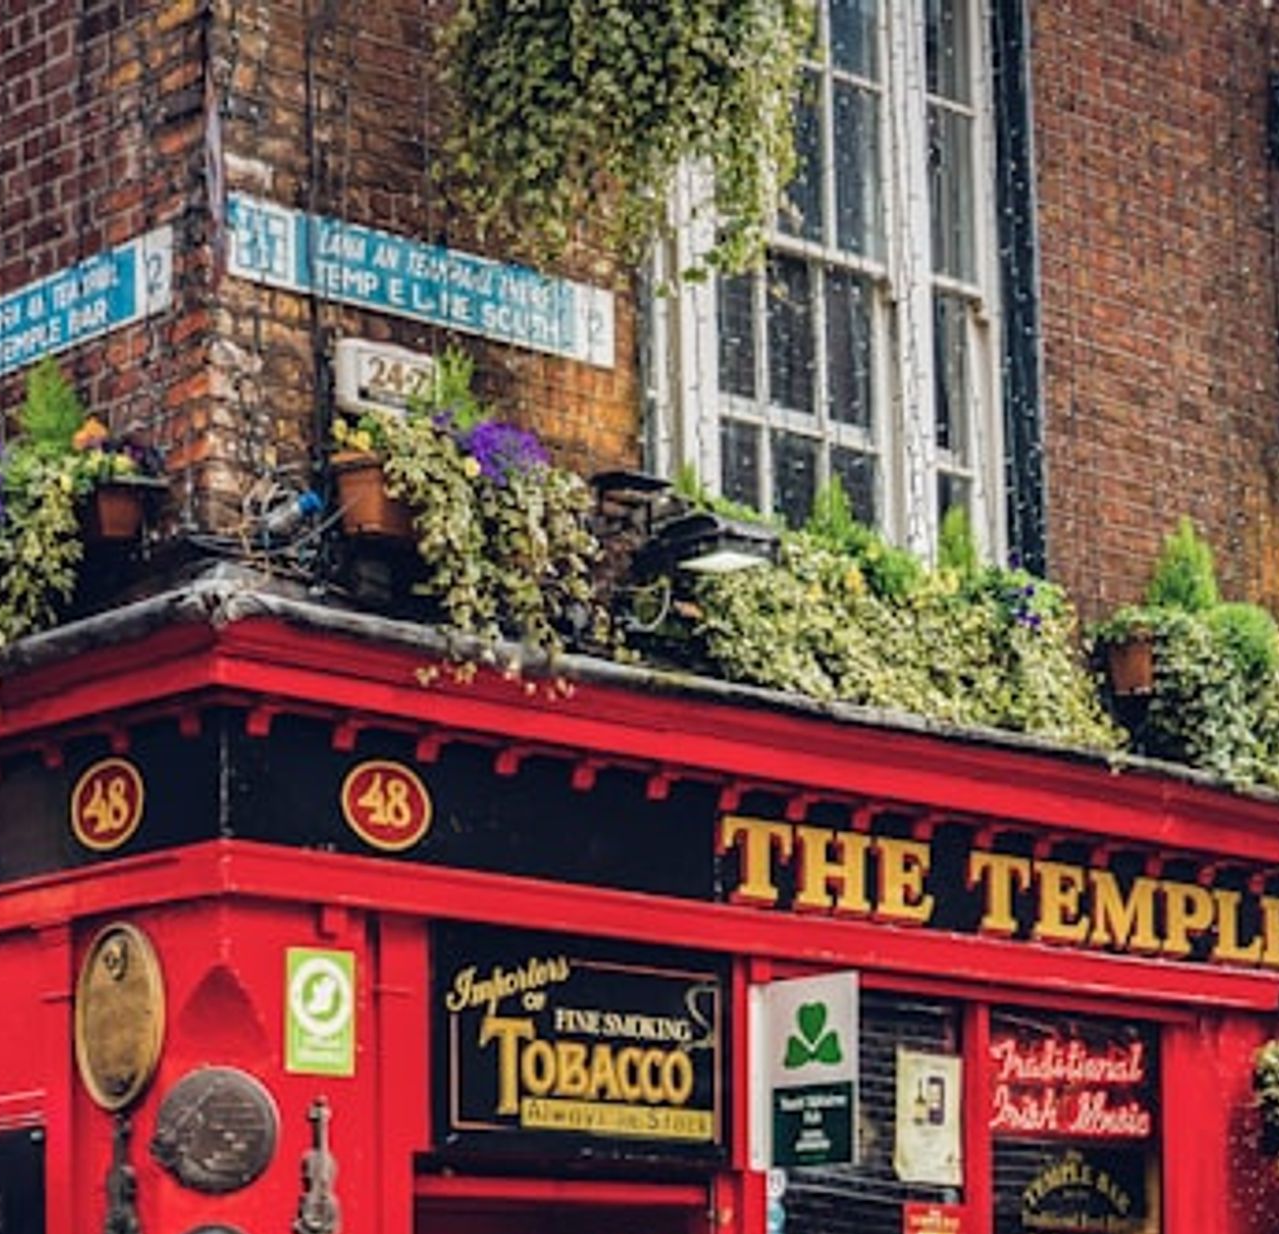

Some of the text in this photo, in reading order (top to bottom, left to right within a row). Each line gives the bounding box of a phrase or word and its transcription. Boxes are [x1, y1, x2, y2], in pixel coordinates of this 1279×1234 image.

[69, 299, 108, 337] BAR
[481, 302, 560, 346] SOUTH
[83, 775, 130, 834] 48
[357, 773, 412, 829] 48
[723, 815, 935, 924] THE
[446, 956, 570, 1017] Importers
[555, 1008, 692, 1041] FINE SMOKING
[479, 1016, 694, 1116] TOBACCO
[988, 1038, 1144, 1083] Traditional
[988, 1084, 1151, 1136] Irish Music
